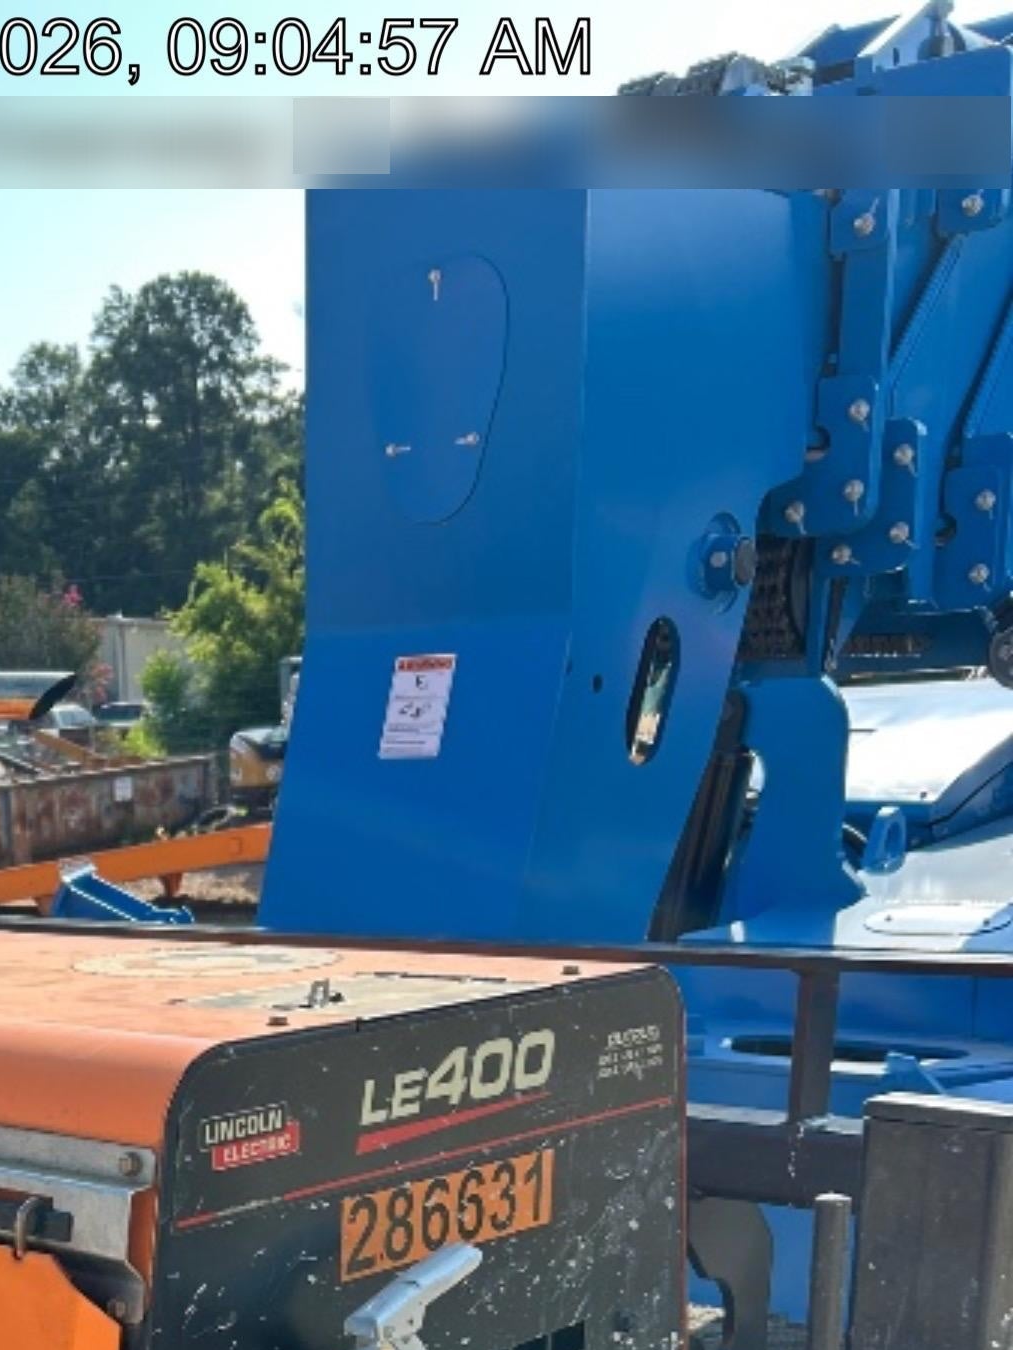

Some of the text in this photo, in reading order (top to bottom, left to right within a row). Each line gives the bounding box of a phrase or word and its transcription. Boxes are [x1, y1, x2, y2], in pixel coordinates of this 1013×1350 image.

[360, 1029, 555, 1126] LE400
[205, 1109, 282, 1145] LINCOLN
[345, 1150, 545, 1277] 286631
